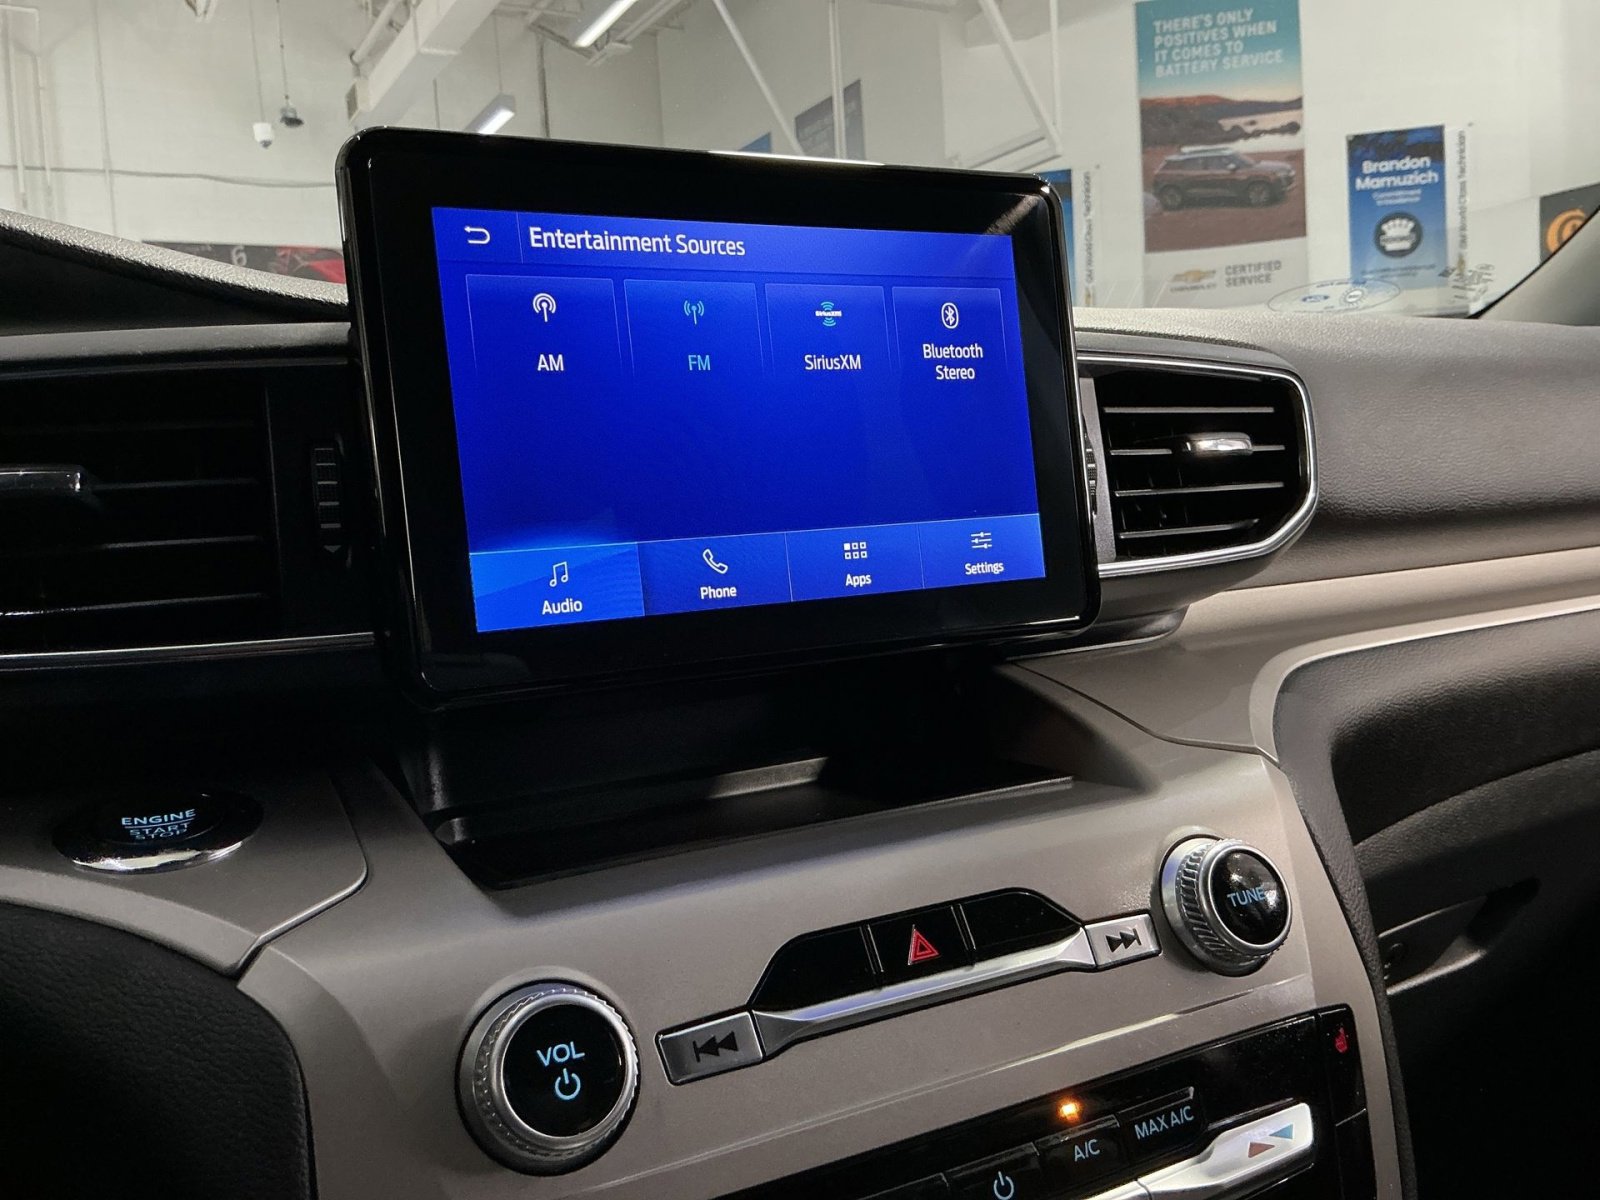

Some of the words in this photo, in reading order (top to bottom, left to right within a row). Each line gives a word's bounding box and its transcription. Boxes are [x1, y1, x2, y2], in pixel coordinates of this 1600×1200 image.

[1153, 13, 1213, 34] THERE'S
[1216, 8, 1254, 25] ONLY
[1154, 27, 1229, 49] POSITIVES
[1232, 20, 1278, 38] WHEN
[1154, 49, 1168, 63] IT
[1171, 43, 1222, 62] COMES
[1225, 40, 1244, 55] TO
[1155, 58, 1218, 78] BATTERY
[1222, 49, 1284, 70] SERVICE
[1362, 156, 1431, 174] Brandon
[529, 226, 672, 254] Entertainment
[676, 234, 746, 257] Sources
[1225, 260, 1282, 276] CERTIFIED
[1225, 273, 1272, 288] SERVICE
[922, 343, 983, 361] Bluetooth
[537, 354, 564, 372] AM
[688, 354, 711, 371] FM
[804, 354, 862, 370] SiriusXM
[935, 364, 976, 382] Stereo
[965, 560, 1004, 577] Settings
[845, 573, 872, 589] Apps
[700, 584, 737, 601] Phone
[541, 597, 583, 616] Audio
[121, 808, 196, 826] ENGINE
[129, 821, 191, 836] START
[135, 829, 187, 840] STOP
[1227, 886, 1265, 907] TUNE
[536, 1041, 585, 1067] VOL
[1134, 1114, 1169, 1140] MAX
[1170, 1105, 1195, 1127] A/C
[1074, 1138, 1100, 1162] A/C
